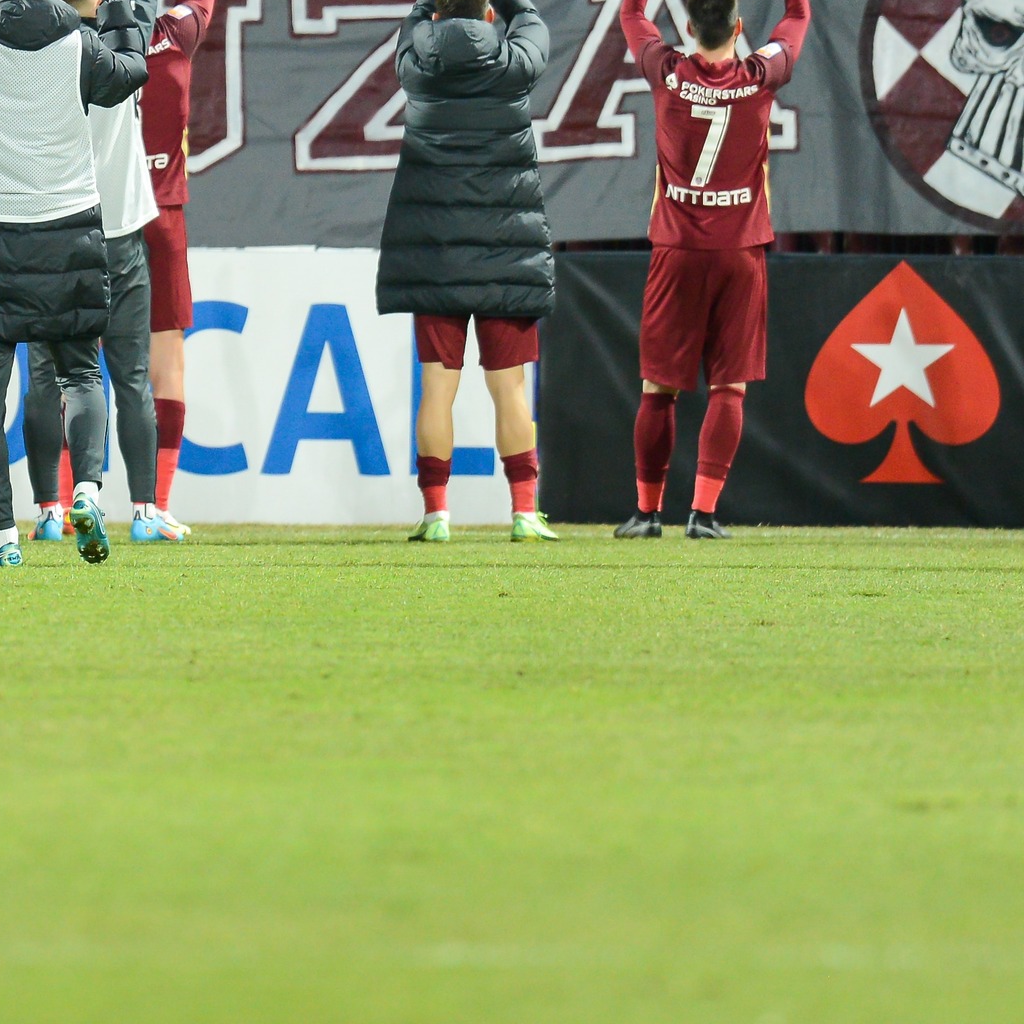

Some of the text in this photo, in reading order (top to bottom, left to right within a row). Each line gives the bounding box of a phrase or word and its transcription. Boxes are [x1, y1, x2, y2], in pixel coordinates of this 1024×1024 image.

[679, 90, 716, 105] CASINO
[681, 81, 759, 100] POKERSTARS
[691, 104, 732, 187] 7
[665, 183, 701, 204] NTT
